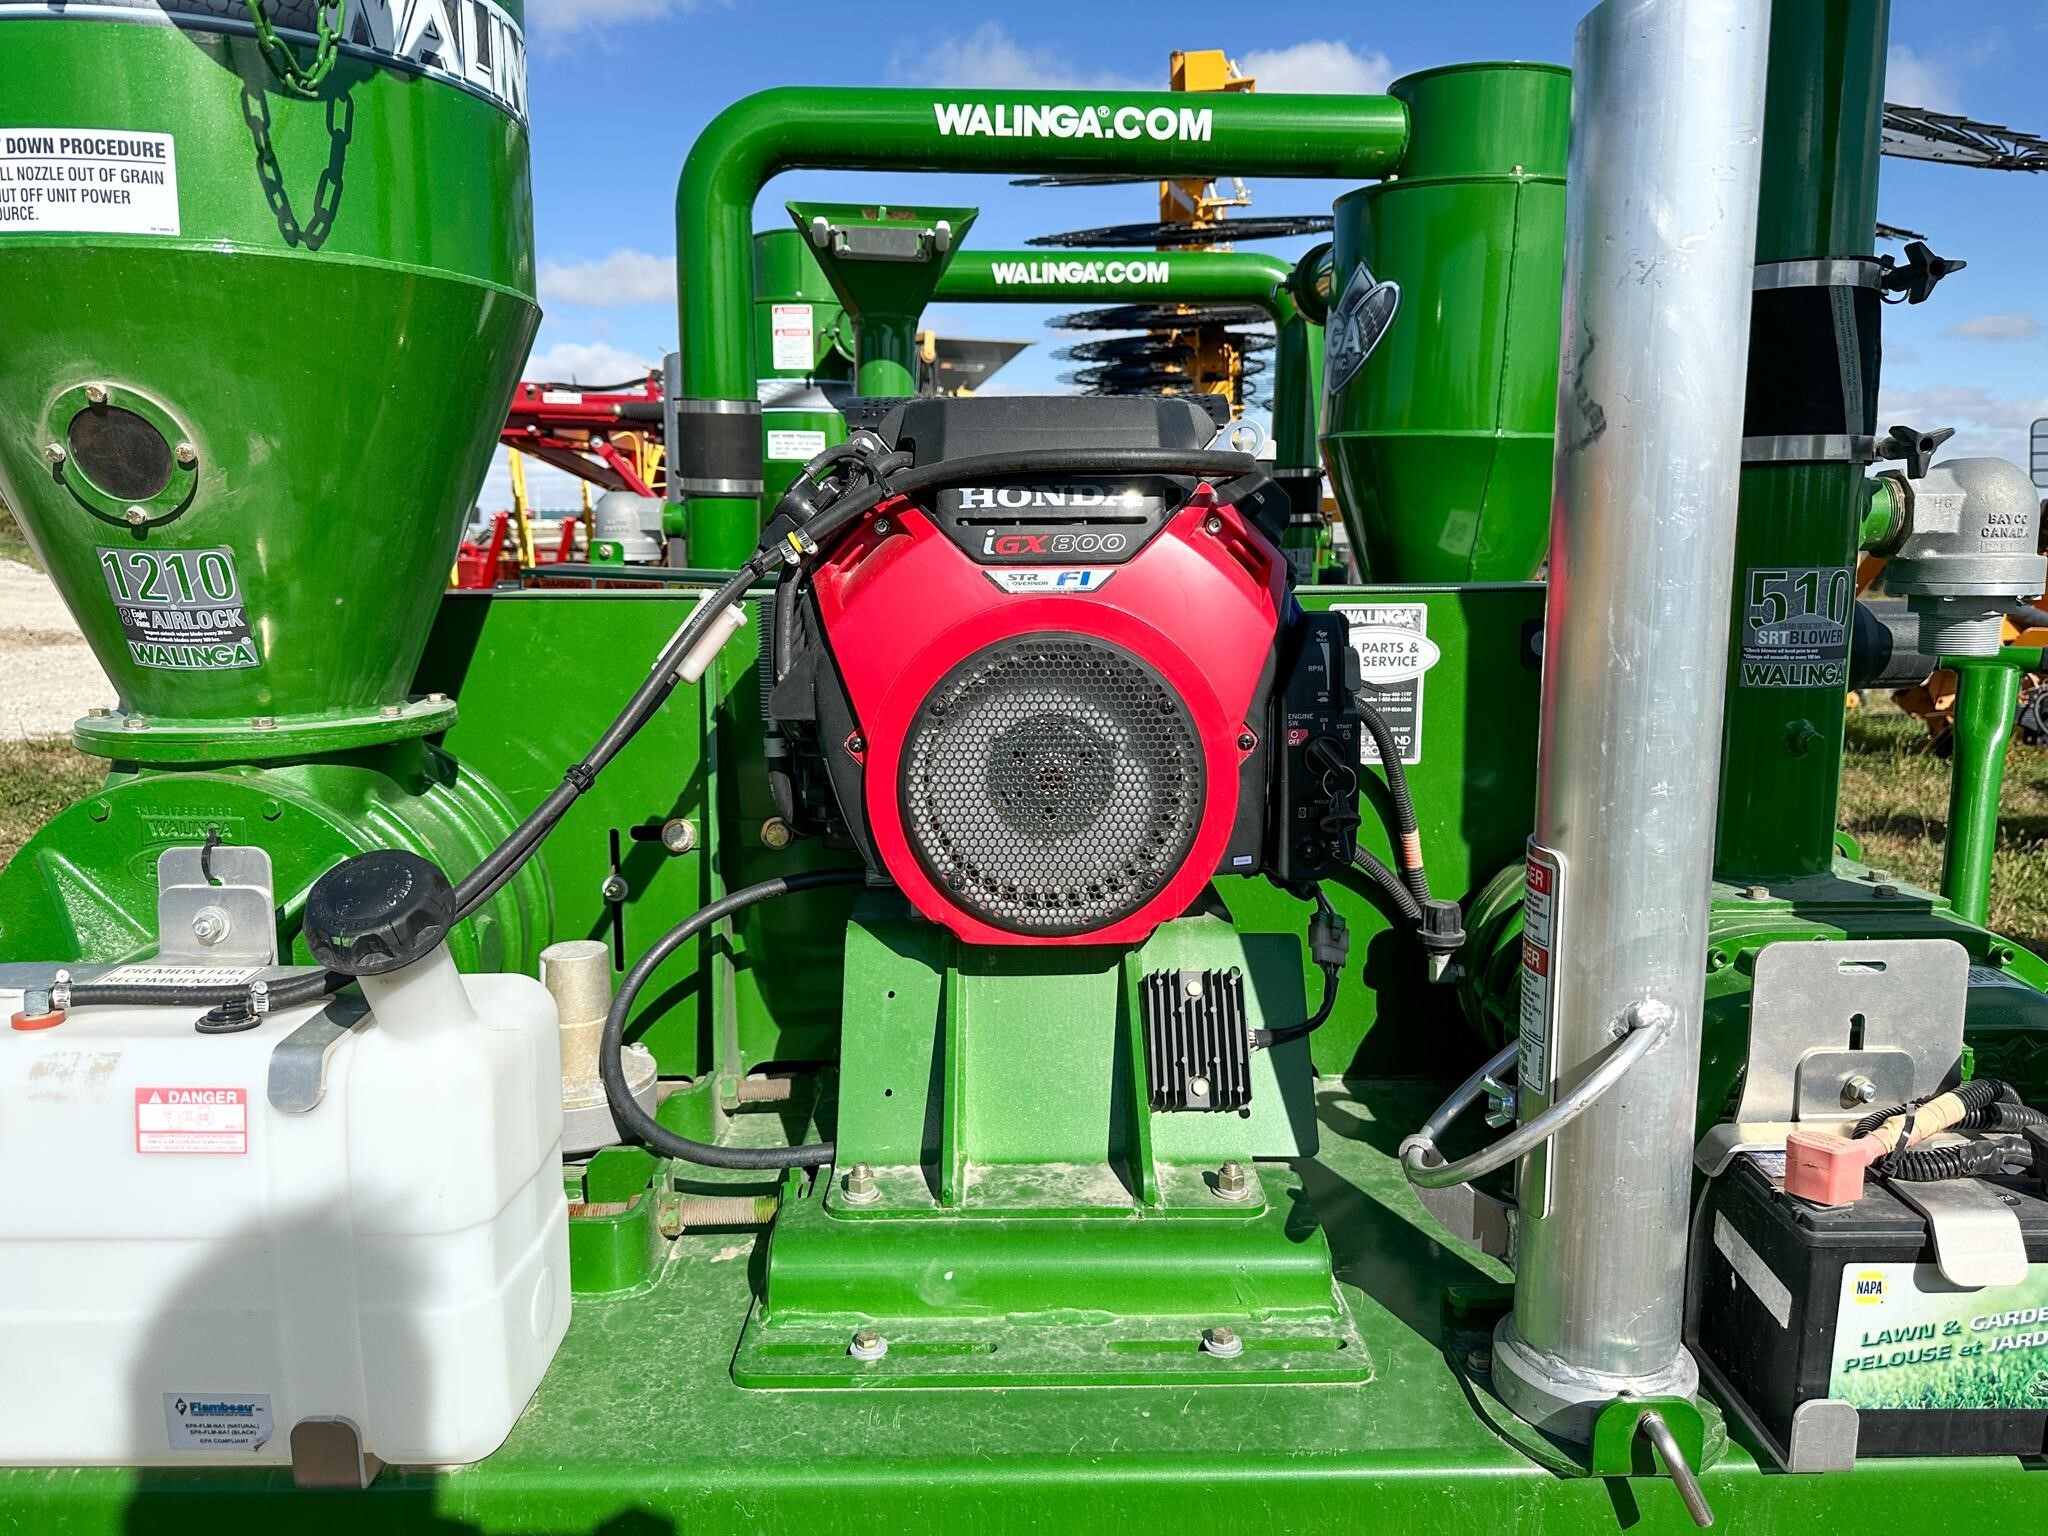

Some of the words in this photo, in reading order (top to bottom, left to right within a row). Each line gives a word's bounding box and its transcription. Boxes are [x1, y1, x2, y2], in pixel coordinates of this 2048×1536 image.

[6, 137, 54, 154] DOWN
[60, 138, 166, 159] PROCEDURE
[17, 166, 64, 181] NOZZLE
[68, 167, 95, 182] OUT
[99, 168, 116, 183] OF
[121, 169, 165, 185] GRAIN
[20, 188, 43, 203] OFF
[47, 188, 77, 203] UNIT
[81, 188, 131, 205] POWER
[958, 484, 1144, 509] HONDA
[101, 551, 236, 603] 1210
[1007, 573, 1039, 581] STR
[1749, 569, 1850, 630] 510
[152, 608, 245, 629] AIRLOCK
[1362, 642, 1404, 653] PARTS
[1409, 642, 1419, 653] &
[1363, 656, 1417, 667] SERVICE
[1744, 662, 1844, 686] WALINGA
[104, 976, 239, 984] RECOMMENDED
[122, 967, 204, 975] PREMIUM
[168, 1090, 237, 1104] DANGER
[1856, 1281, 1883, 1294] NAPA
[1860, 1322, 1936, 1348] LAWN
[1941, 1319, 1963, 1337] &
[1843, 1343, 1953, 1373] PELOUSE
[1958, 1339, 1983, 1357] et
[1986, 1330, 2048, 1354] JARD
[189, 1402, 253, 1414] Flambeau
